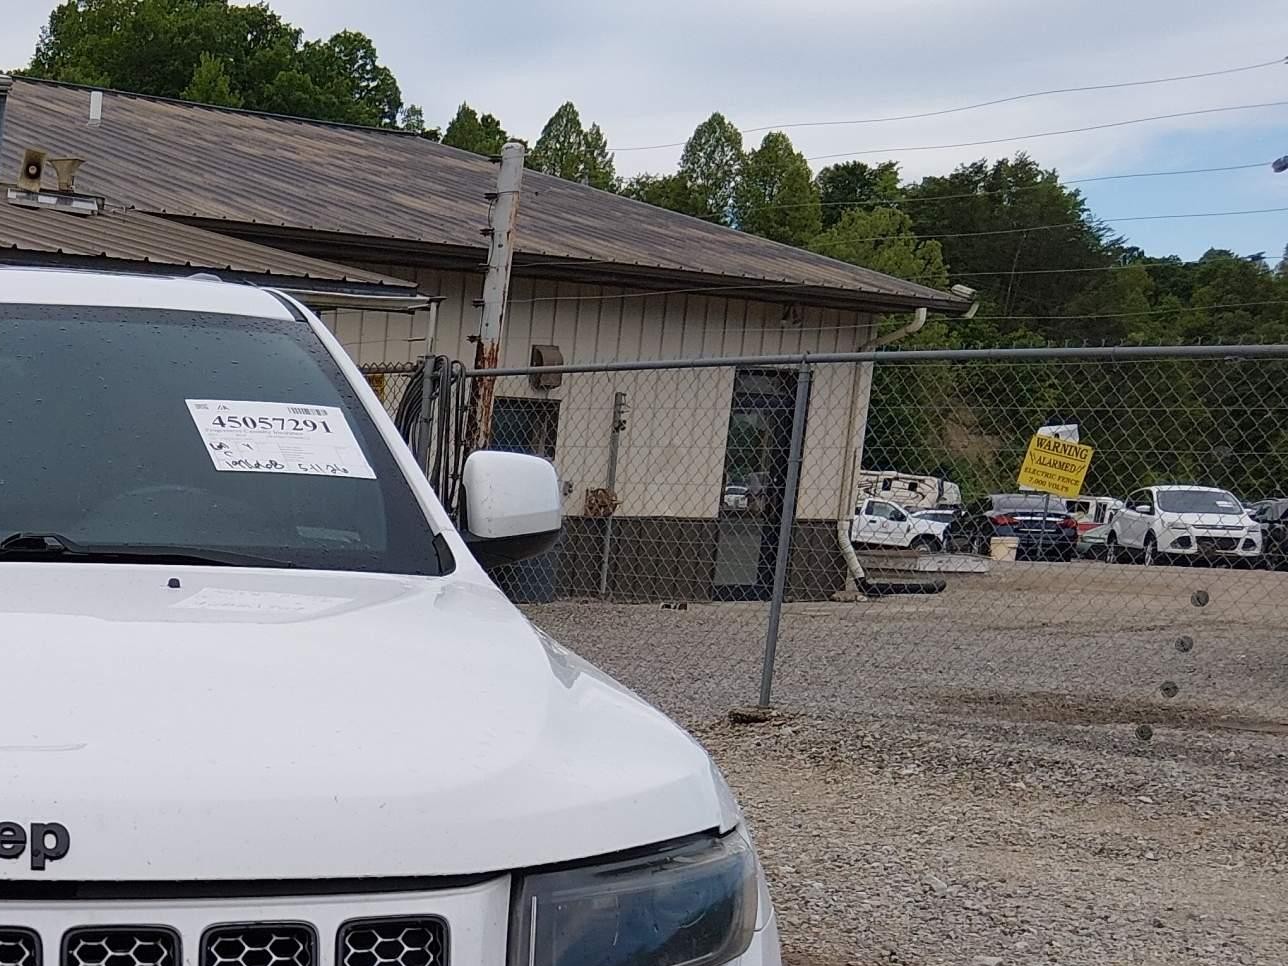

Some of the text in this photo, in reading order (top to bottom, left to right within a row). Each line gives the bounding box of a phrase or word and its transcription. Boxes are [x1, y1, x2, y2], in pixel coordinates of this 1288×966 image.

[212, 415, 332, 433] 45057291
[1036, 437, 1088, 460] WARNING
[1035, 456, 1076, 473] ALARMED
[1024, 467, 1080, 486] ELECTRIC FENCE
[1048, 481, 1069, 492] VOLTS
